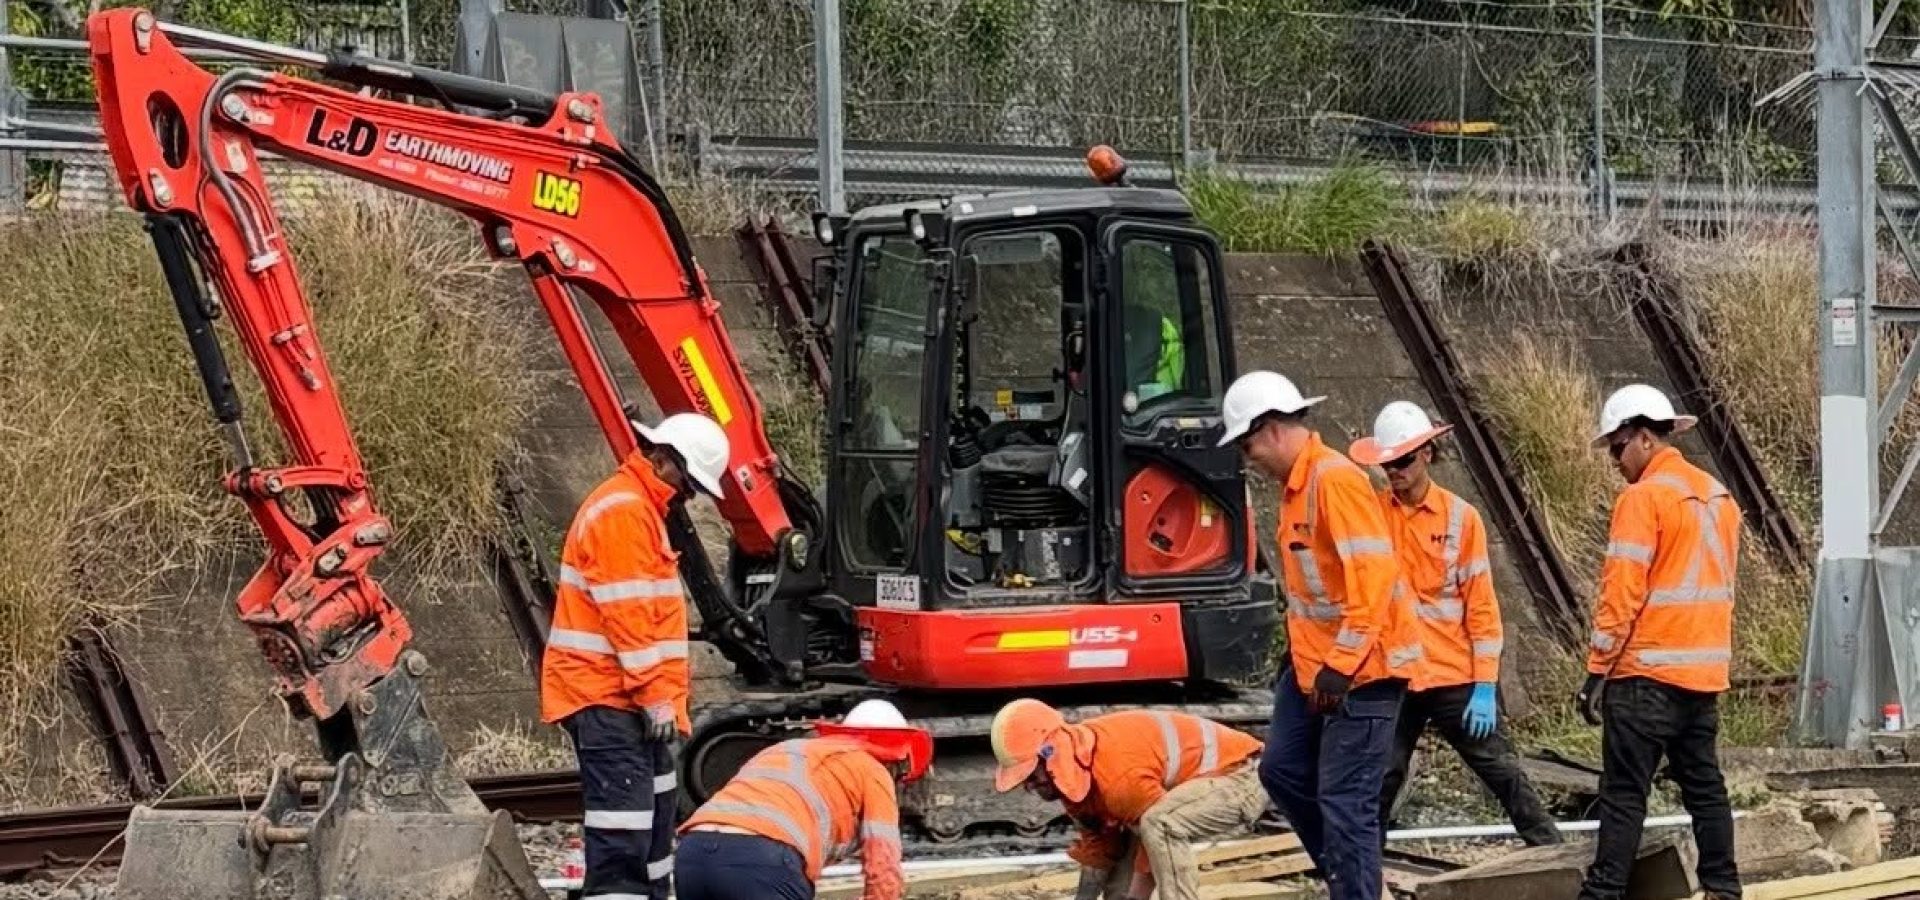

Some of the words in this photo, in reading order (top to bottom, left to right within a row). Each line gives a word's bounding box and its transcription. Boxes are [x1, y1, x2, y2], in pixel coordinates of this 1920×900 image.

[306, 107, 379, 158] L&D
[384, 129, 513, 185] EARTHMOVING
[533, 170, 582, 218] LD56
